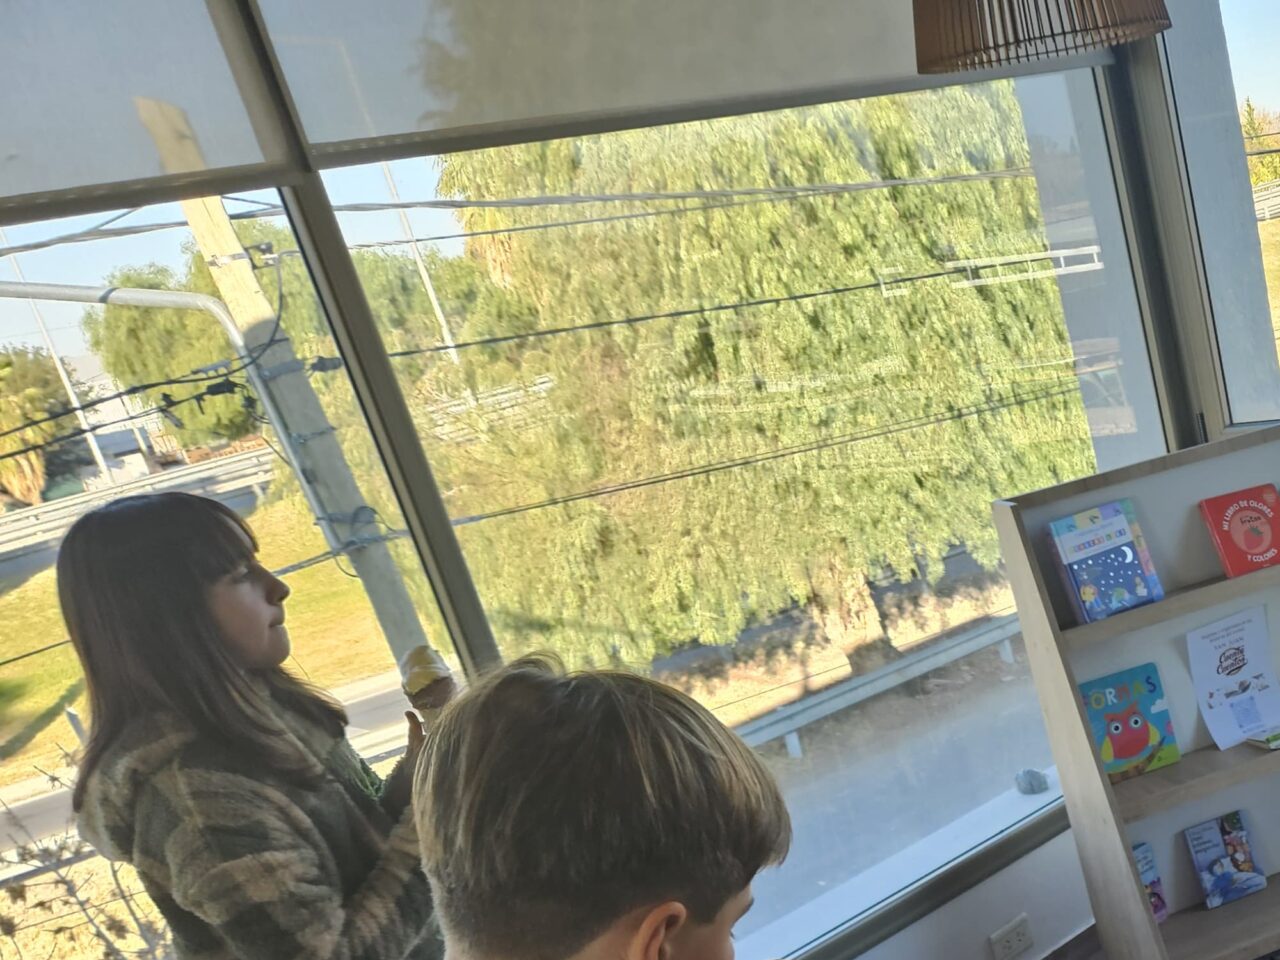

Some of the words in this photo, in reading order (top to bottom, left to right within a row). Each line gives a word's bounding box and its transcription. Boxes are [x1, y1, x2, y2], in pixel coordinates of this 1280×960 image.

[1224, 504, 1239, 520] LIBRO
[1249, 500, 1273, 517] OLORES
[1252, 548, 1278, 562] COLORES
